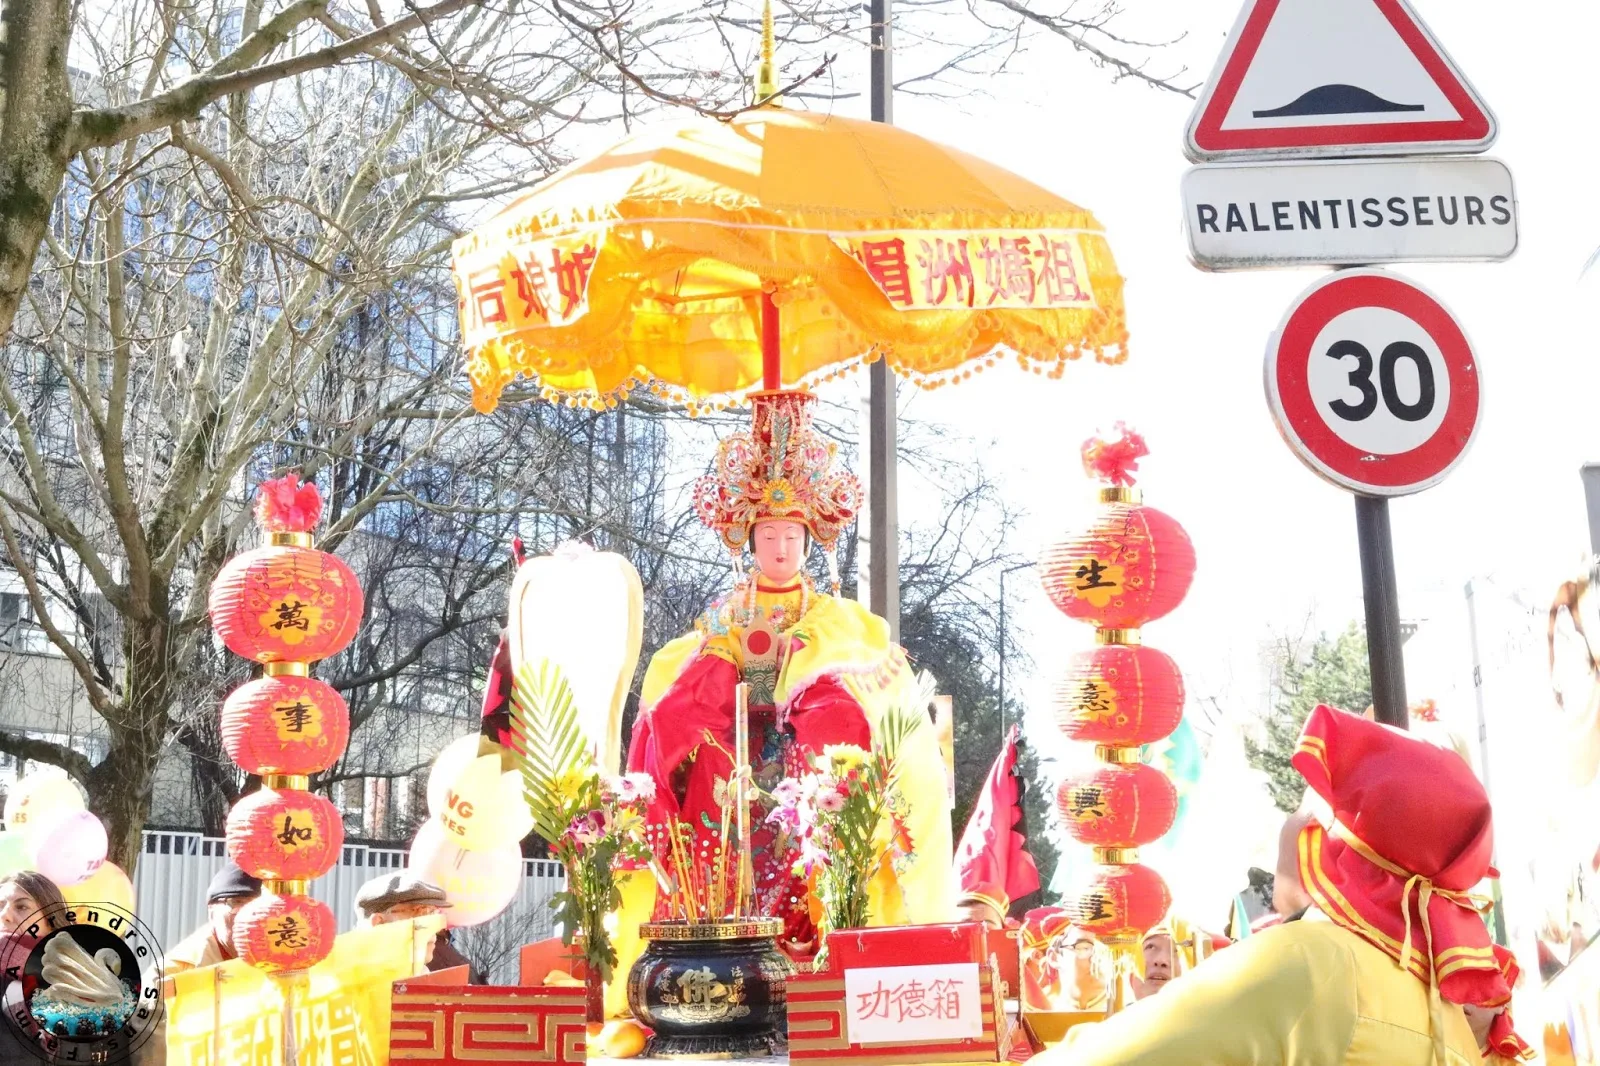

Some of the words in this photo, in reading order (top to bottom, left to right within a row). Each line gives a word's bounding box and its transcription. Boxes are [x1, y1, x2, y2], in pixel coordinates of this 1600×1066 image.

[1196, 195, 1512, 234] RALENTISSEURS
[1325, 339, 1436, 422] 30
[1075, 559, 1117, 591] 生
[269, 600, 309, 632] 萬
[275, 702, 314, 733] 事
[276, 816, 312, 846] 如
[268, 917, 309, 948] 意
[856, 978, 964, 1023] 功德箱
